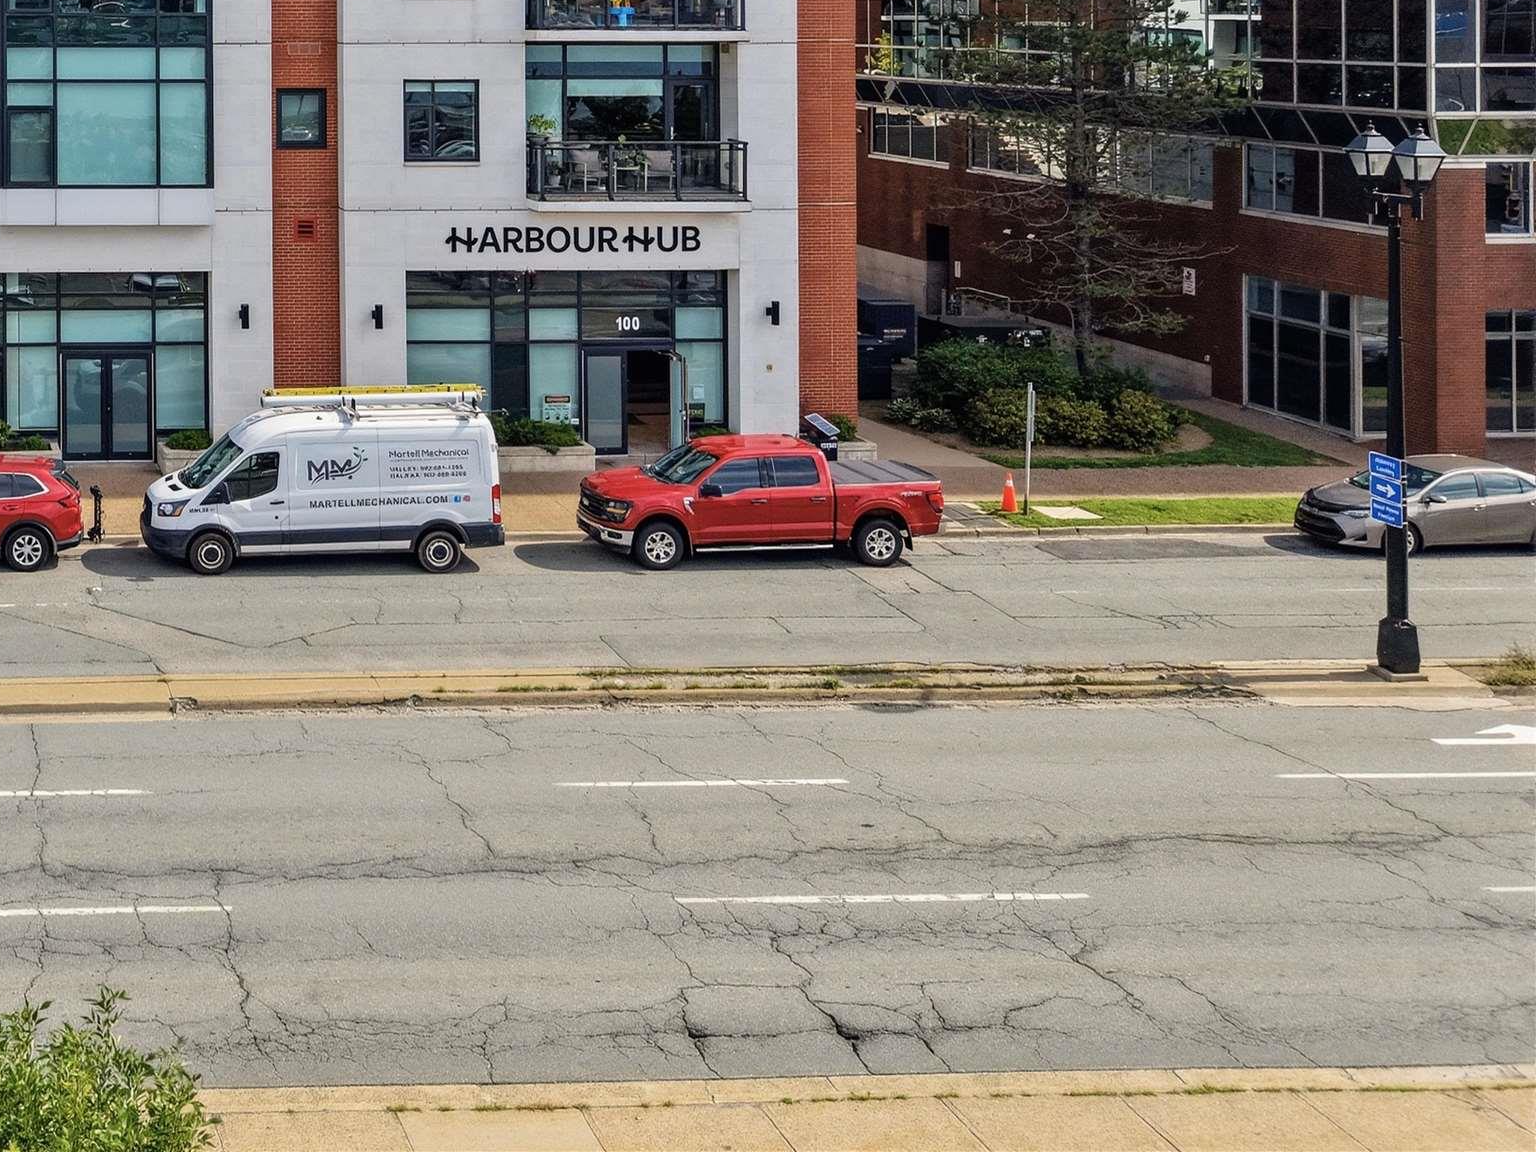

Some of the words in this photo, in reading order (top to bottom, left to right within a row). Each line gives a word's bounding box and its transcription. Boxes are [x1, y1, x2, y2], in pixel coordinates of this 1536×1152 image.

[445, 225, 620, 254] HARBOUR
[621, 225, 702, 253] HUB
[615, 315, 641, 332] 100
[309, 495, 449, 509] MARTELLMECHANICAL.COM
